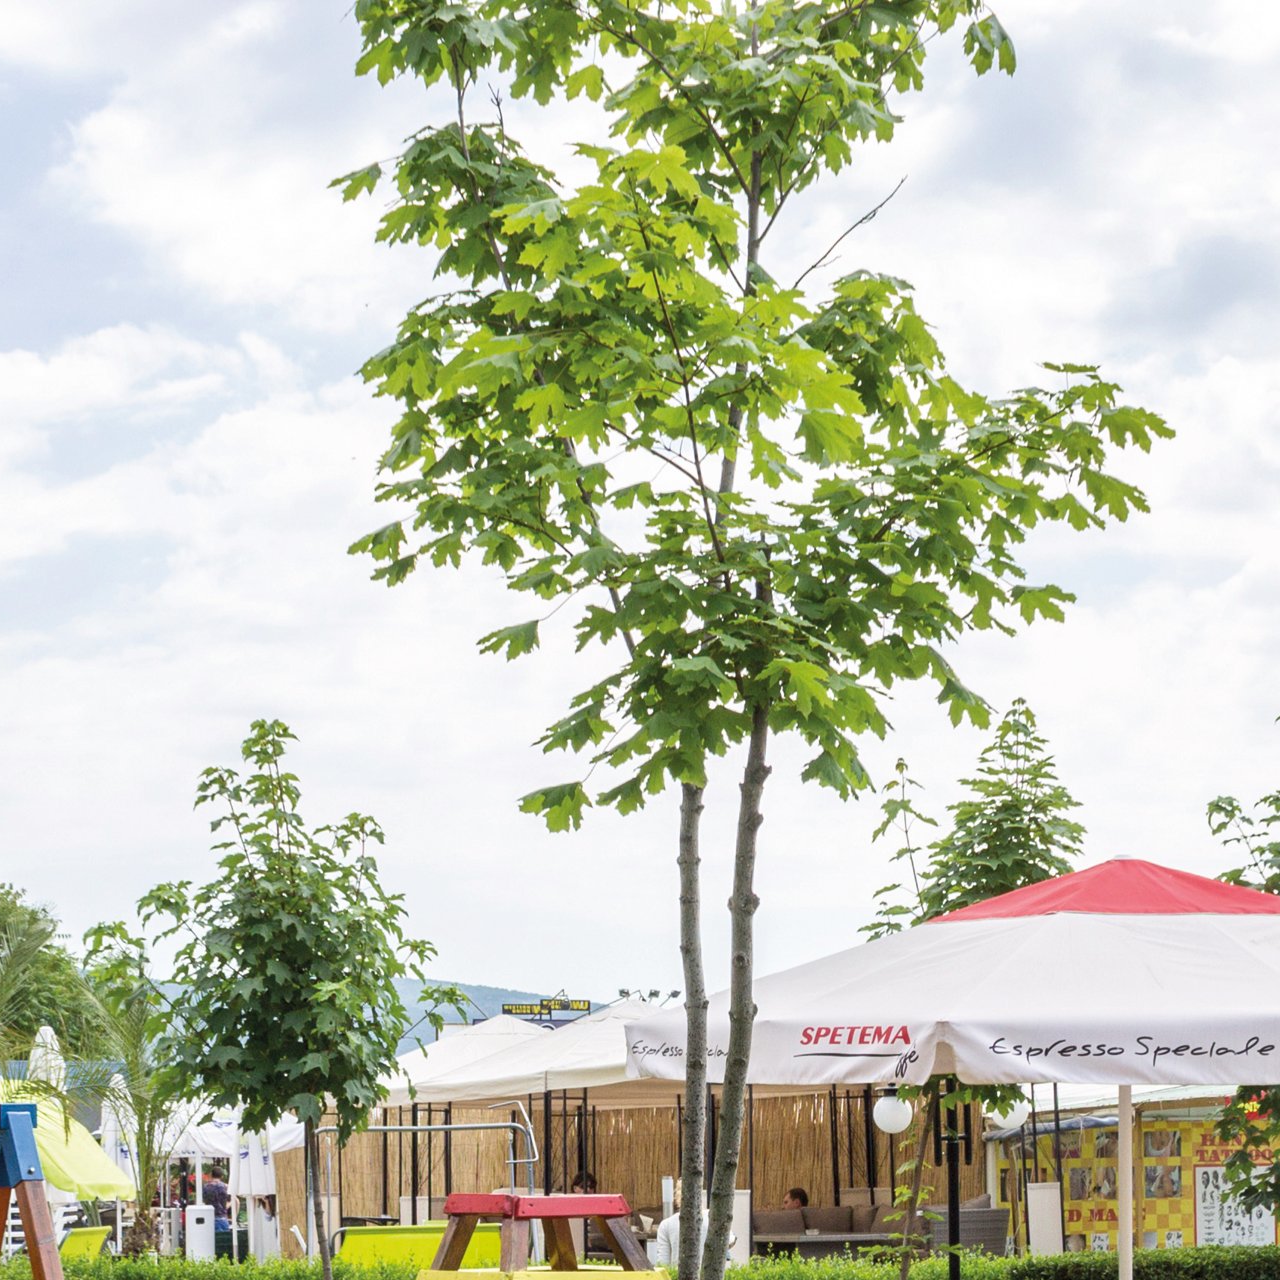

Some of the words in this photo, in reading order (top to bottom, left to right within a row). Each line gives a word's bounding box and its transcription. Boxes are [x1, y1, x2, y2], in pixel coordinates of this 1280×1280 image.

[800, 1025, 911, 1045] SPETEMA
[631, 1040, 683, 1062] Espresso
[989, 1037, 1125, 1065] Espresso
[1135, 1036, 1275, 1067] Speciale
